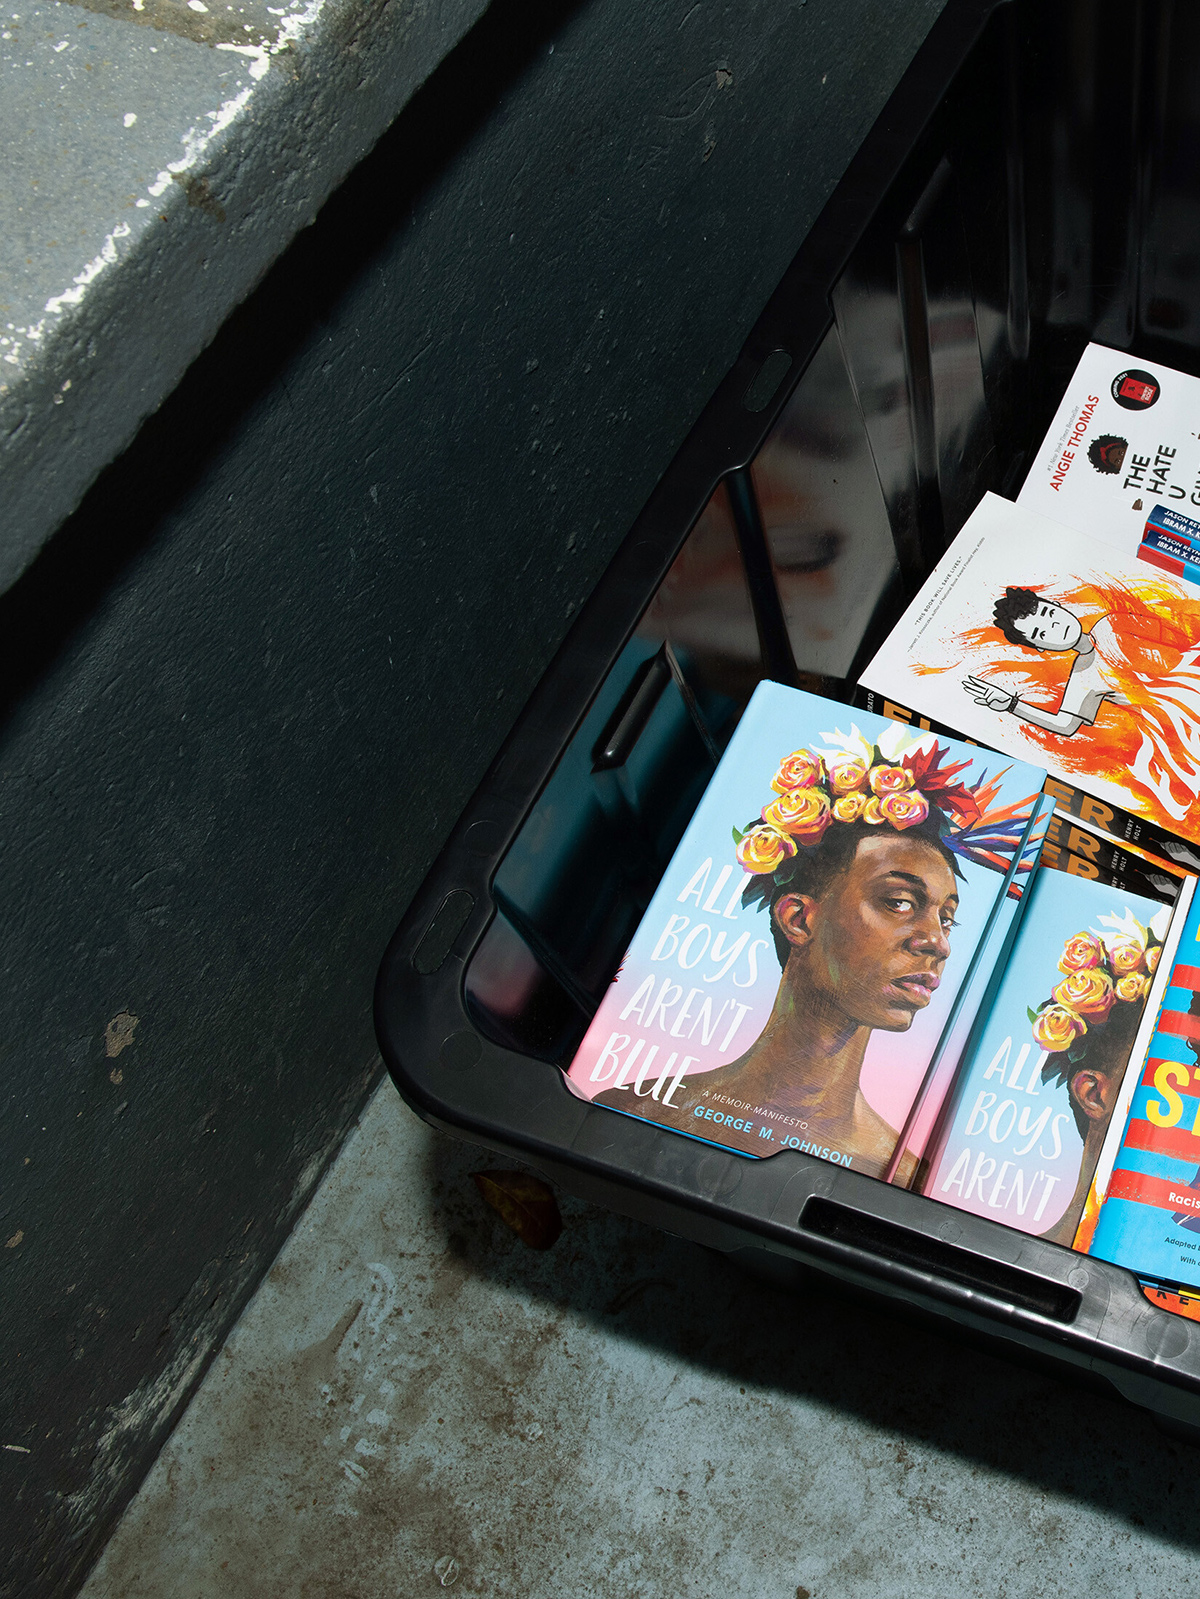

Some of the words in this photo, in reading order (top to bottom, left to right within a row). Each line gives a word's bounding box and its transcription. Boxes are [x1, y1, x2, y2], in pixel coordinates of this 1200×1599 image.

[1066, 405, 1080, 428] Bestseller
[1049, 450, 1075, 491] ANGIE
[1067, 395, 1100, 447] THOMAS
[1123, 454, 1151, 489] THE
[1146, 444, 1177, 495] HATE
[1168, 484, 1186, 500] U
[1162, 517, 1186, 534] IBRAM
[1186, 526, 1195, 537] X.
[1163, 510, 1188, 525] JASON
[1156, 540, 1180, 556] IBRAM
[1180, 549, 1190, 560] X.
[1157, 534, 1182, 548] JASON
[924, 598, 935, 612] BOOK
[934, 585, 943, 598] WILL
[942, 573, 952, 586] SAVE
[1124, 819, 1134, 839] HENRY
[1133, 825, 1142, 841] HOLT
[1110, 850, 1120, 870] HENRY
[1119, 856, 1128, 872] HOLT
[676, 857, 754, 920] ALL
[650, 913, 770, 988] BOYS
[618, 973, 754, 1052] AREN'T
[589, 1031, 700, 1109] BLUE
[982, 1035, 1050, 1096] ALL
[701, 1089, 710, 1098] A
[711, 1093, 808, 1130] MEMOIR-MANIFESTO
[964, 1090, 1070, 1160] BOYS
[693, 1105, 754, 1134] GEORGE
[758, 1126, 775, 1142] M.
[780, 1134, 853, 1168] JOHNSON
[940, 1148, 1061, 1222] AREN'T
[1164, 1236, 1197, 1253] Adapted
[1180, 1255, 1197, 1266] With
